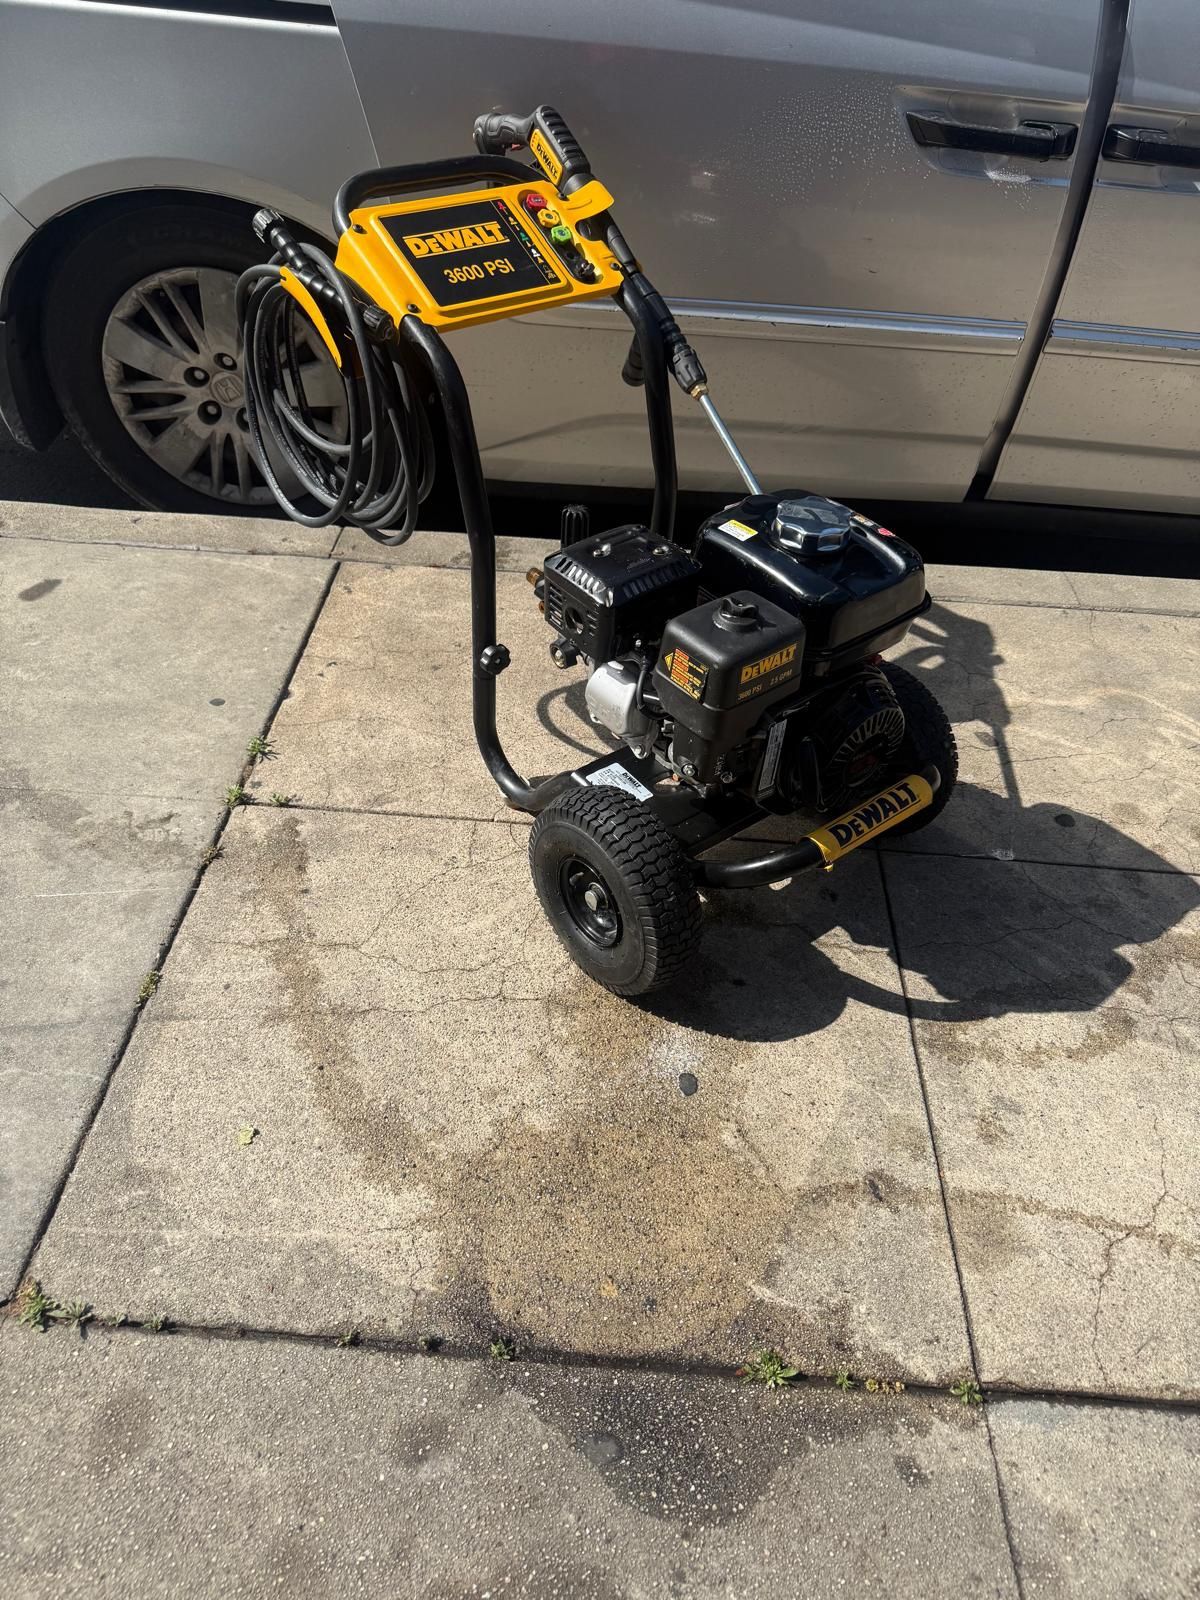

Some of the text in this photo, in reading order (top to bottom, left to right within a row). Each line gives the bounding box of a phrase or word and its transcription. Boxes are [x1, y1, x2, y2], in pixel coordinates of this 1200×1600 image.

[403, 222, 507, 256] DEWALT
[443, 257, 516, 284] 3600 PSI
[740, 645, 797, 682] DEWALT
[827, 782, 918, 847] DEWALT
